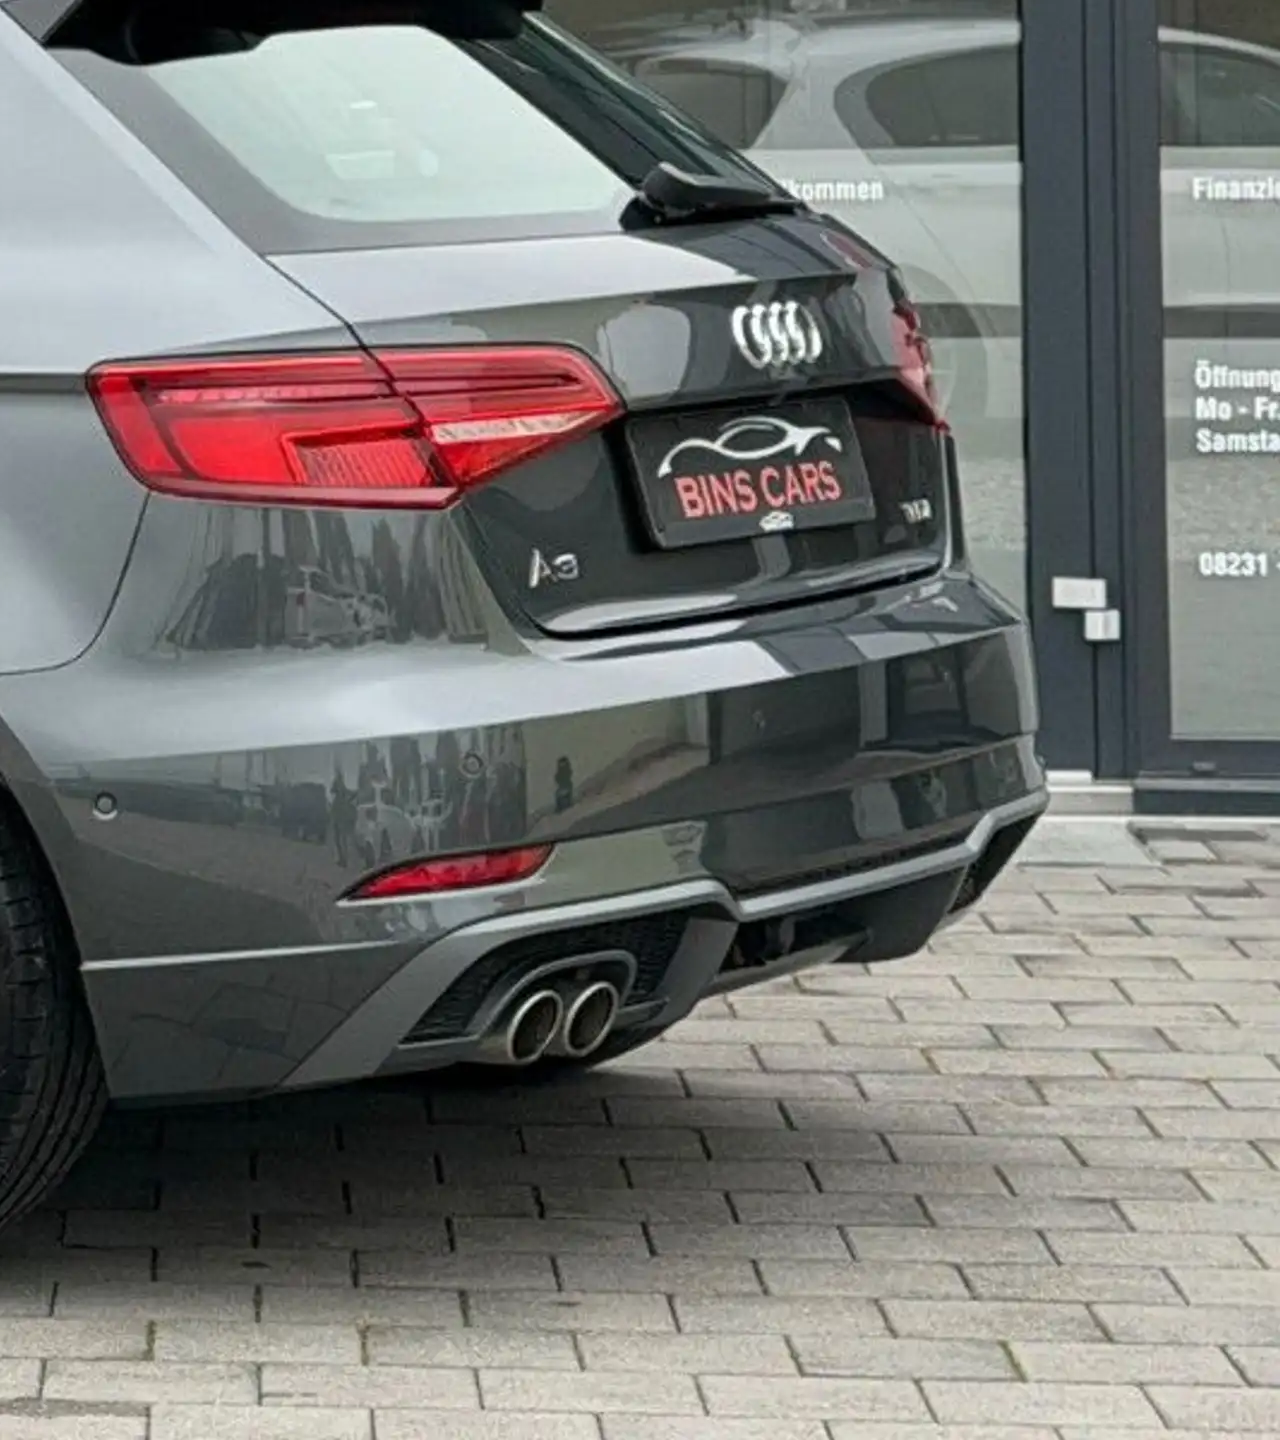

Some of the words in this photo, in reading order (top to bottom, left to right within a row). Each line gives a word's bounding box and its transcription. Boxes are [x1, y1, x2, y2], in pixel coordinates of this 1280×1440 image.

[1195, 396, 1233, 421] Mo
[674, 469, 758, 518] BINS
[759, 460, 842, 508] CARS
[528, 547, 579, 589] A3
[1198, 551, 1268, 577] 08231
